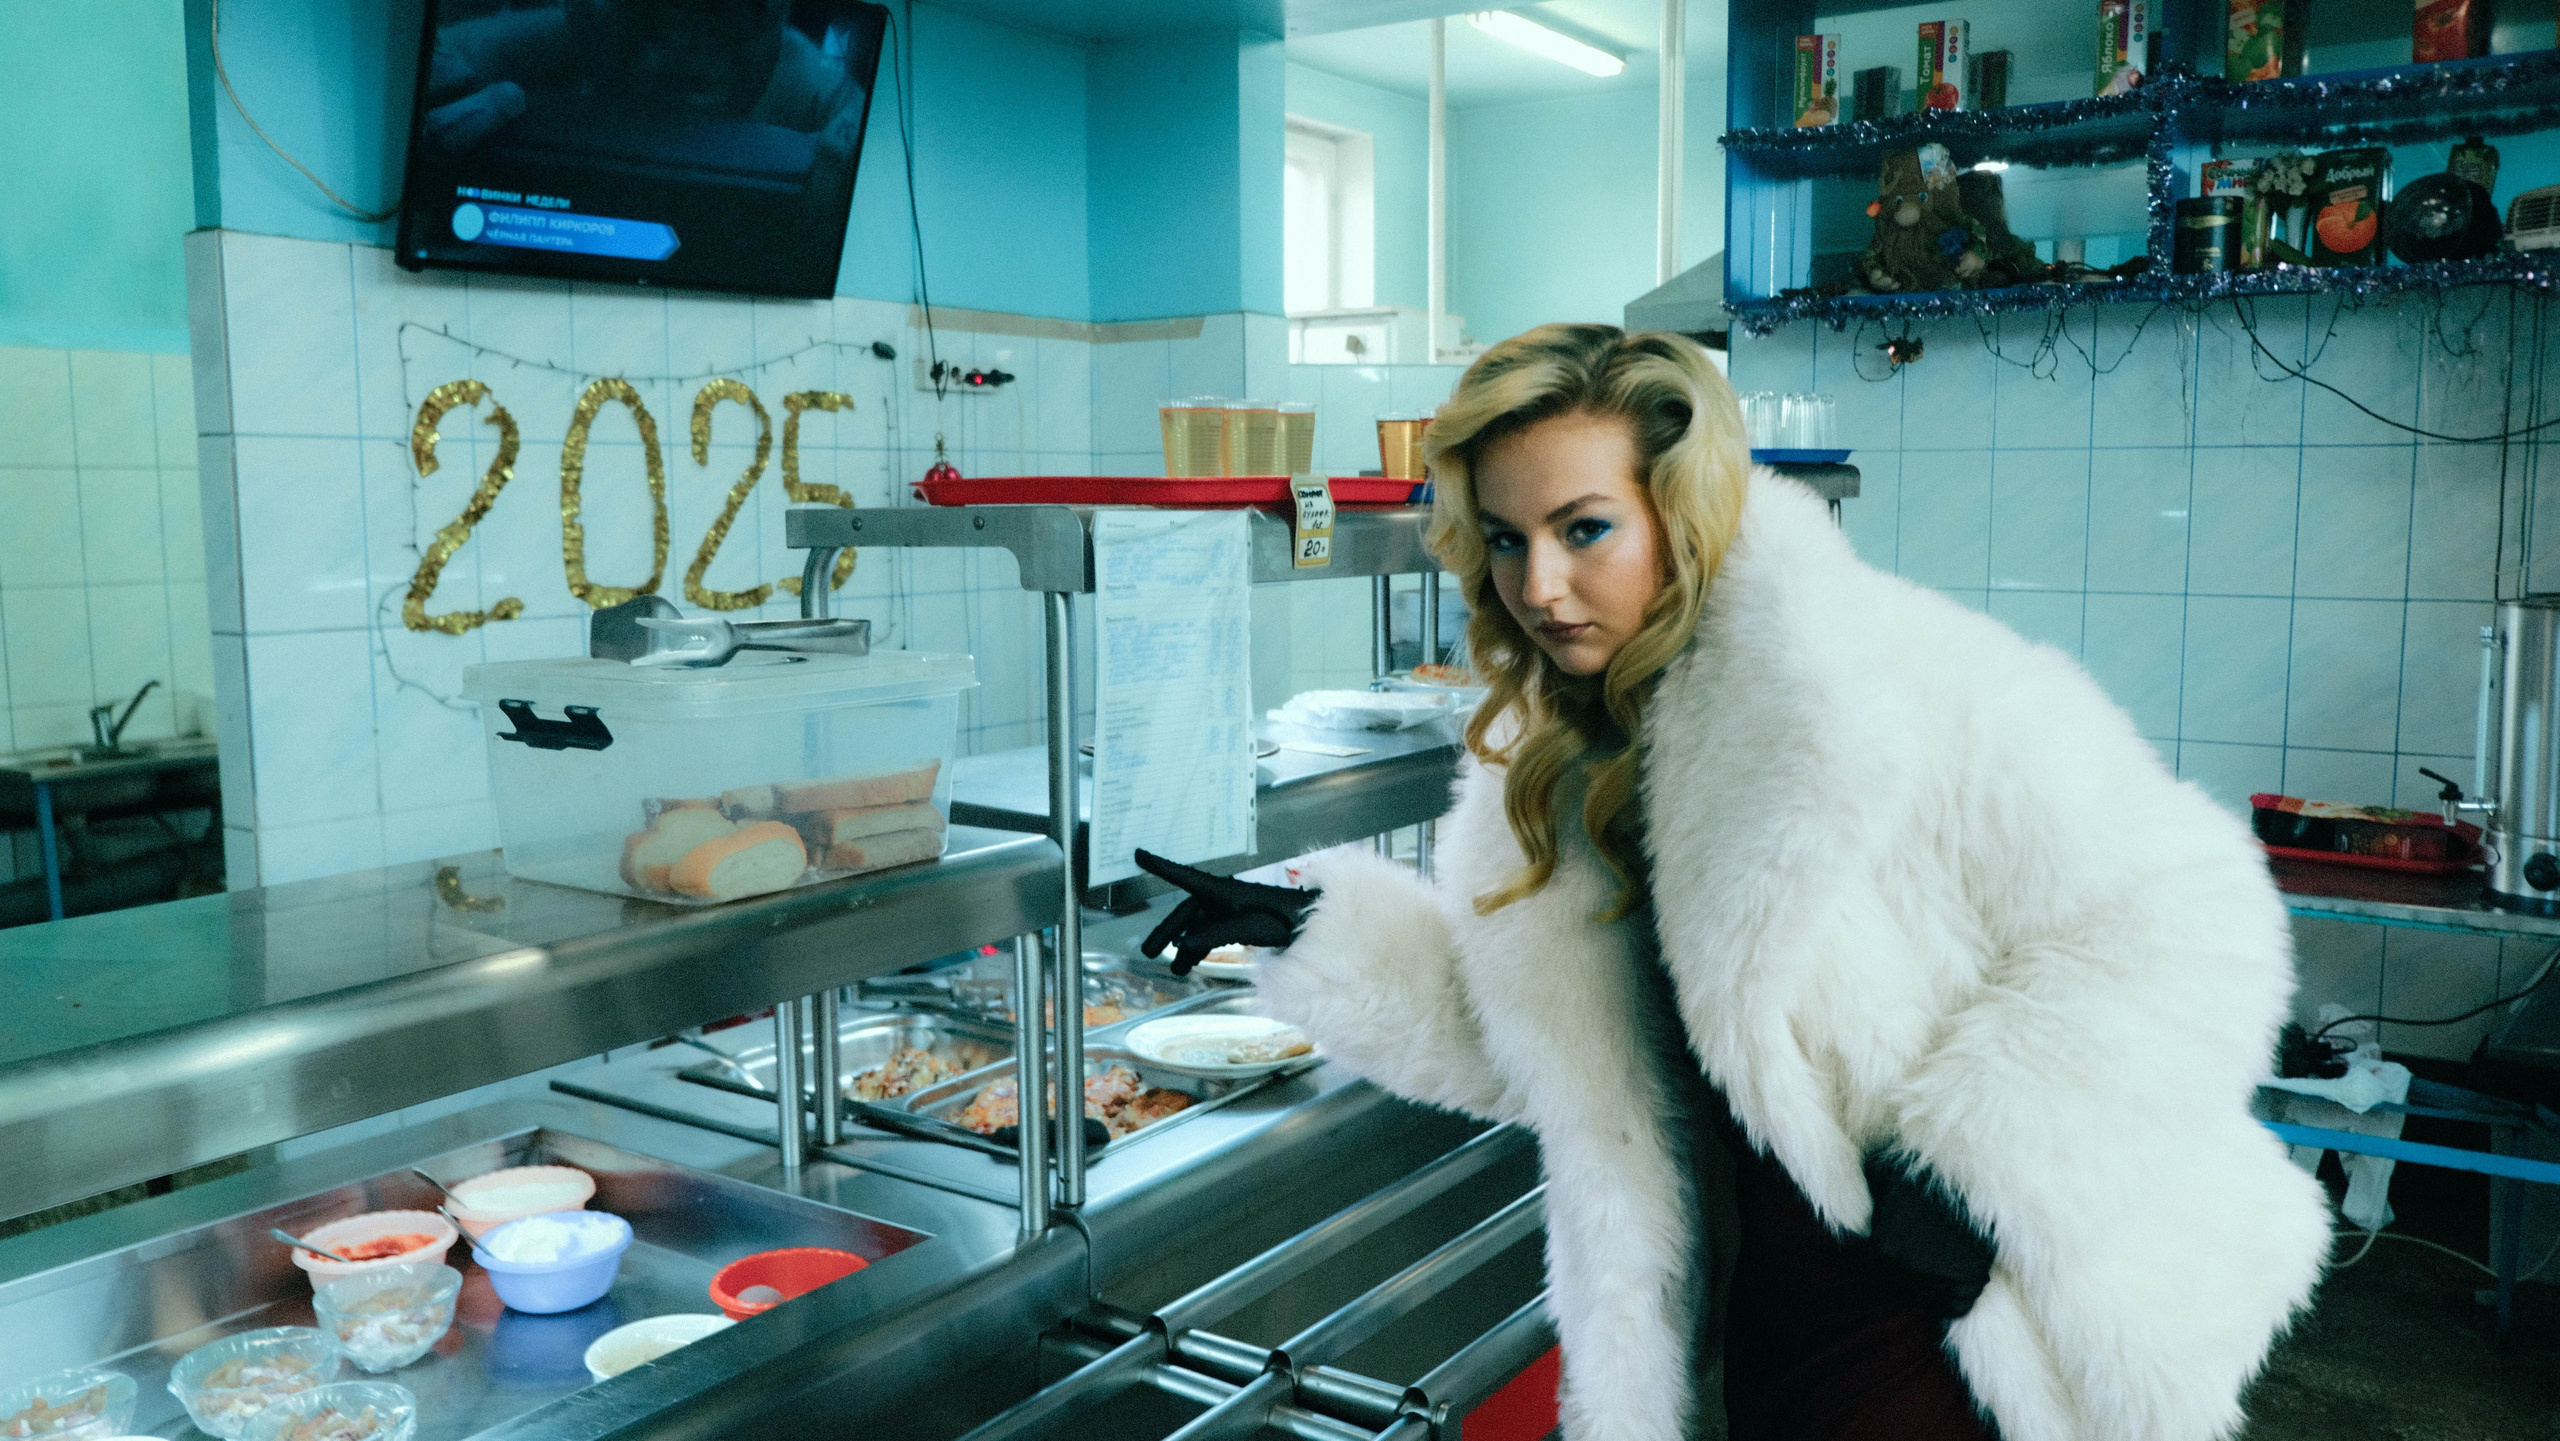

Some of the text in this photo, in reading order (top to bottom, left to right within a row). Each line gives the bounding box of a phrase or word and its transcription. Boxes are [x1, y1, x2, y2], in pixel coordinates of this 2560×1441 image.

[2101, 22, 2115, 73] Яблоко
[1919, 46, 1932, 86] Томат
[2325, 164, 2375, 183] Добрый
[525, 194, 571, 209] НЕДЕЛИ
[488, 211, 616, 236] ФИЛИПП КИРКОРОВ
[401, 377, 857, 636] 2025
